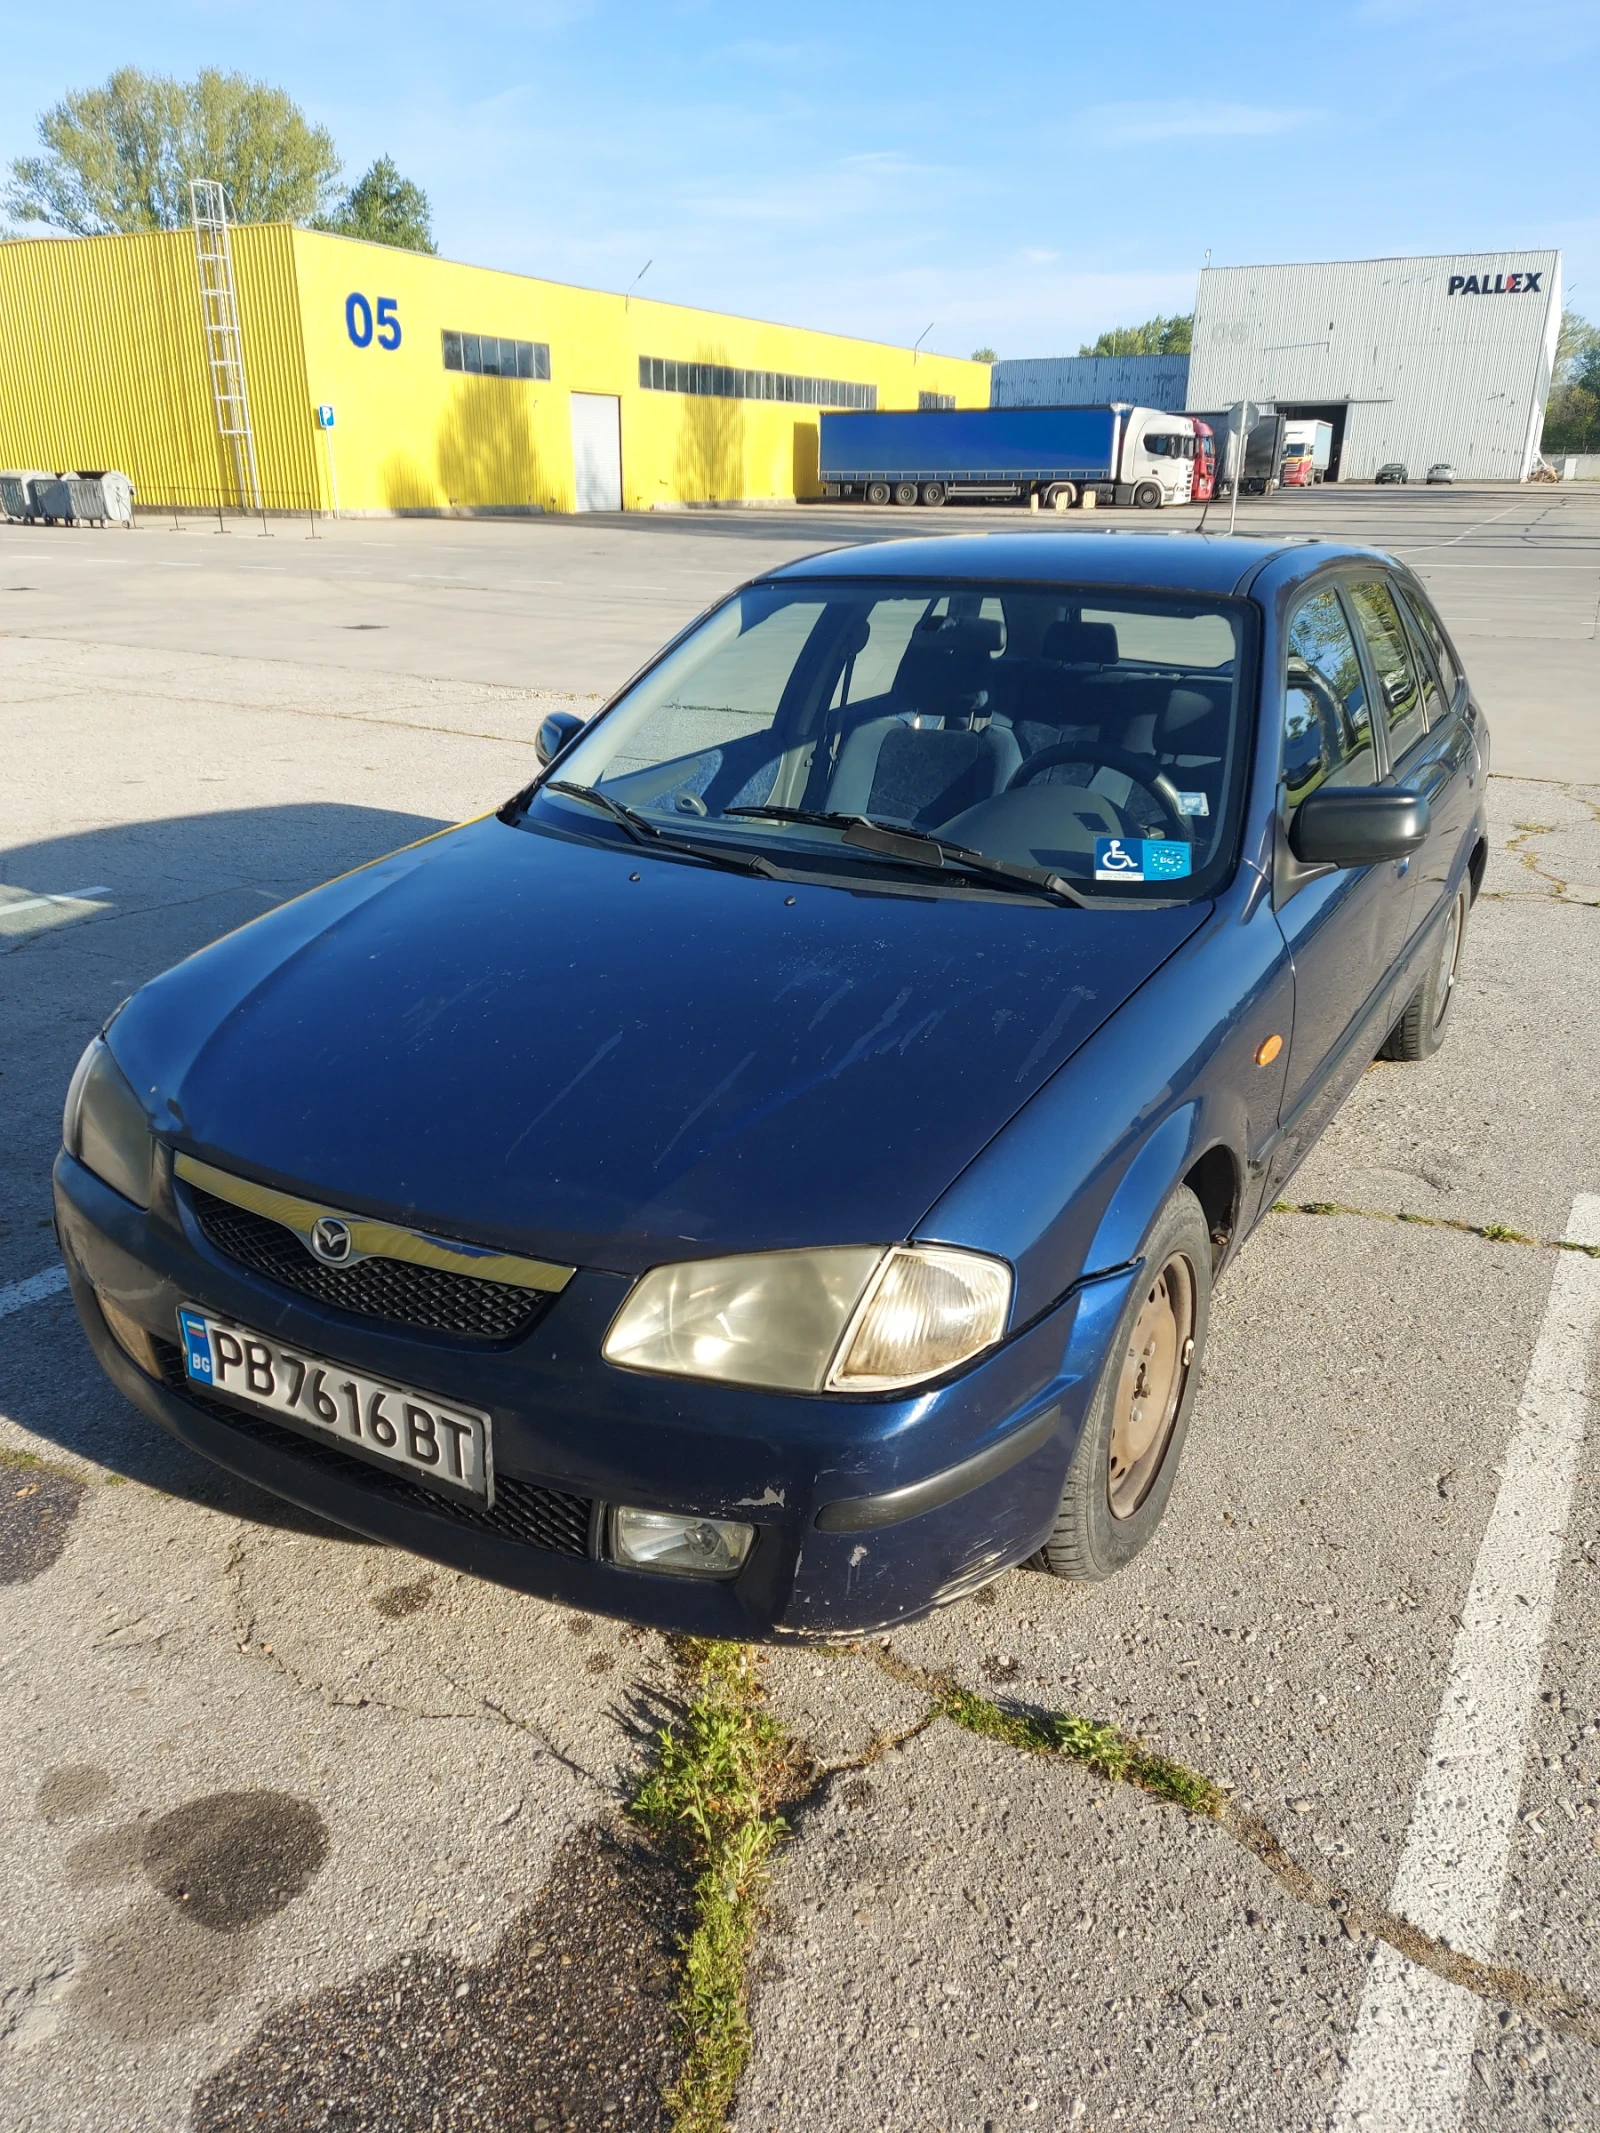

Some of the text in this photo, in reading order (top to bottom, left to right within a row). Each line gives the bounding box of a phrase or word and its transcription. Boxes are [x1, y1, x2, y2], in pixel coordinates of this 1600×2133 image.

[1448, 272, 1543, 295] PALLEX
[345, 291, 402, 351] 05
[1212, 322, 1249, 345] 06
[192, 1352, 211, 1373] BG
